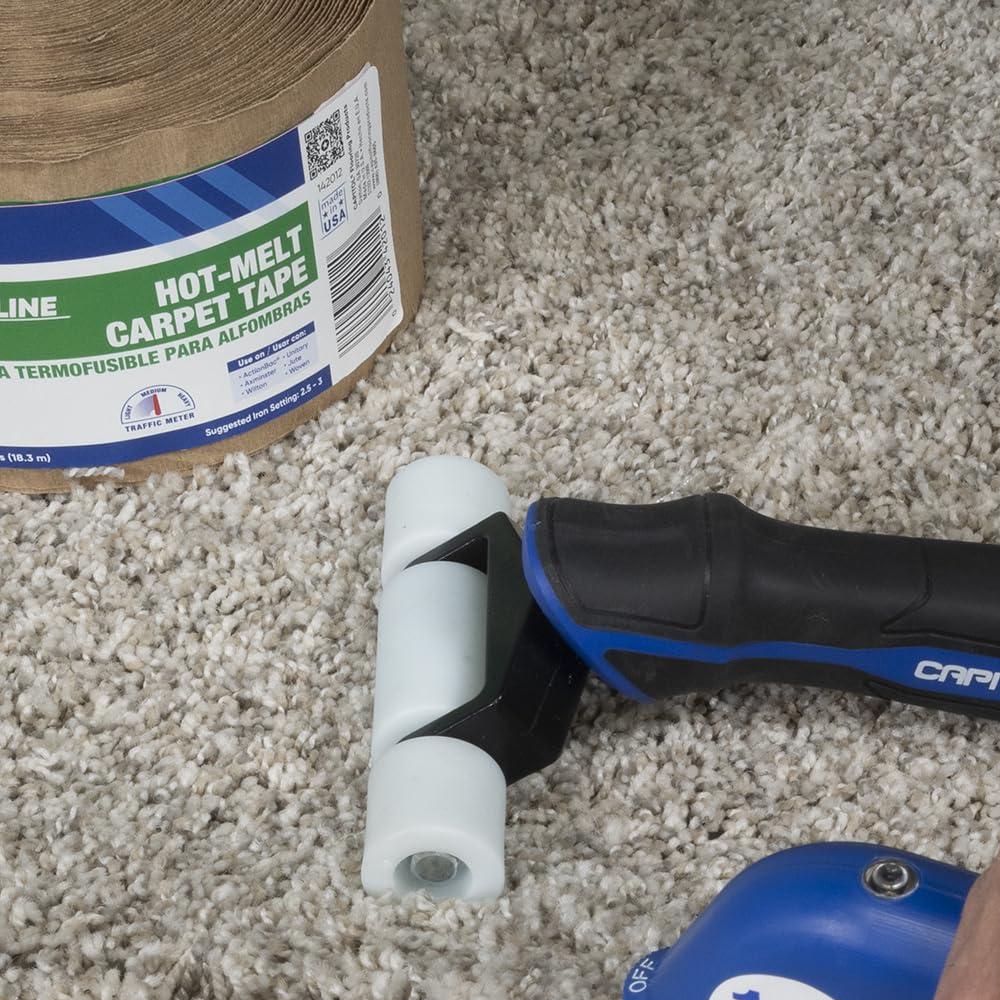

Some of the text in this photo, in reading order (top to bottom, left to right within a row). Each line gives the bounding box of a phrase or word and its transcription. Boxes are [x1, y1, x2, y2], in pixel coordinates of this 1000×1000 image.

[343, 104, 351, 139] Products
[317, 167, 343, 192] 142012
[321, 189, 343, 210] made
[329, 204, 338, 215] in
[323, 208, 346, 233] USA
[154, 224, 303, 307] HOT-MELT
[0, 296, 58, 318] INE
[106, 256, 309, 348] CARPET TAPE
[14, 350, 160, 380] TERMOFUSIBLE
[165, 336, 214, 362] PARA
[217, 291, 311, 347] ALFOMBRAS
[238, 356, 253, 368] Use
[254, 351, 266, 361] on
[272, 341, 290, 352] Usar
[290, 329, 307, 343] con:
[286, 342, 309, 359] Unitary
[288, 355, 302, 367] Jute
[289, 360, 311, 374] Woven
[244, 368, 278, 387] Axminster
[140, 387, 167, 398] MEDIUM
[245, 382, 268, 395] Wilton
[177, 392, 192, 407] HEAVY
[205, 414, 252, 437] Suggested
[253, 407, 269, 420] Iron
[269, 392, 300, 412] Setting:
[300, 383, 312, 397] 2.5
[124, 404, 133, 420] LIGHT
[125, 412, 195, 433] TRAFFIC METER
[7, 452, 34, 463] (18.3
[36, 452, 51, 463] m)
[628, 957, 655, 993] OFF
